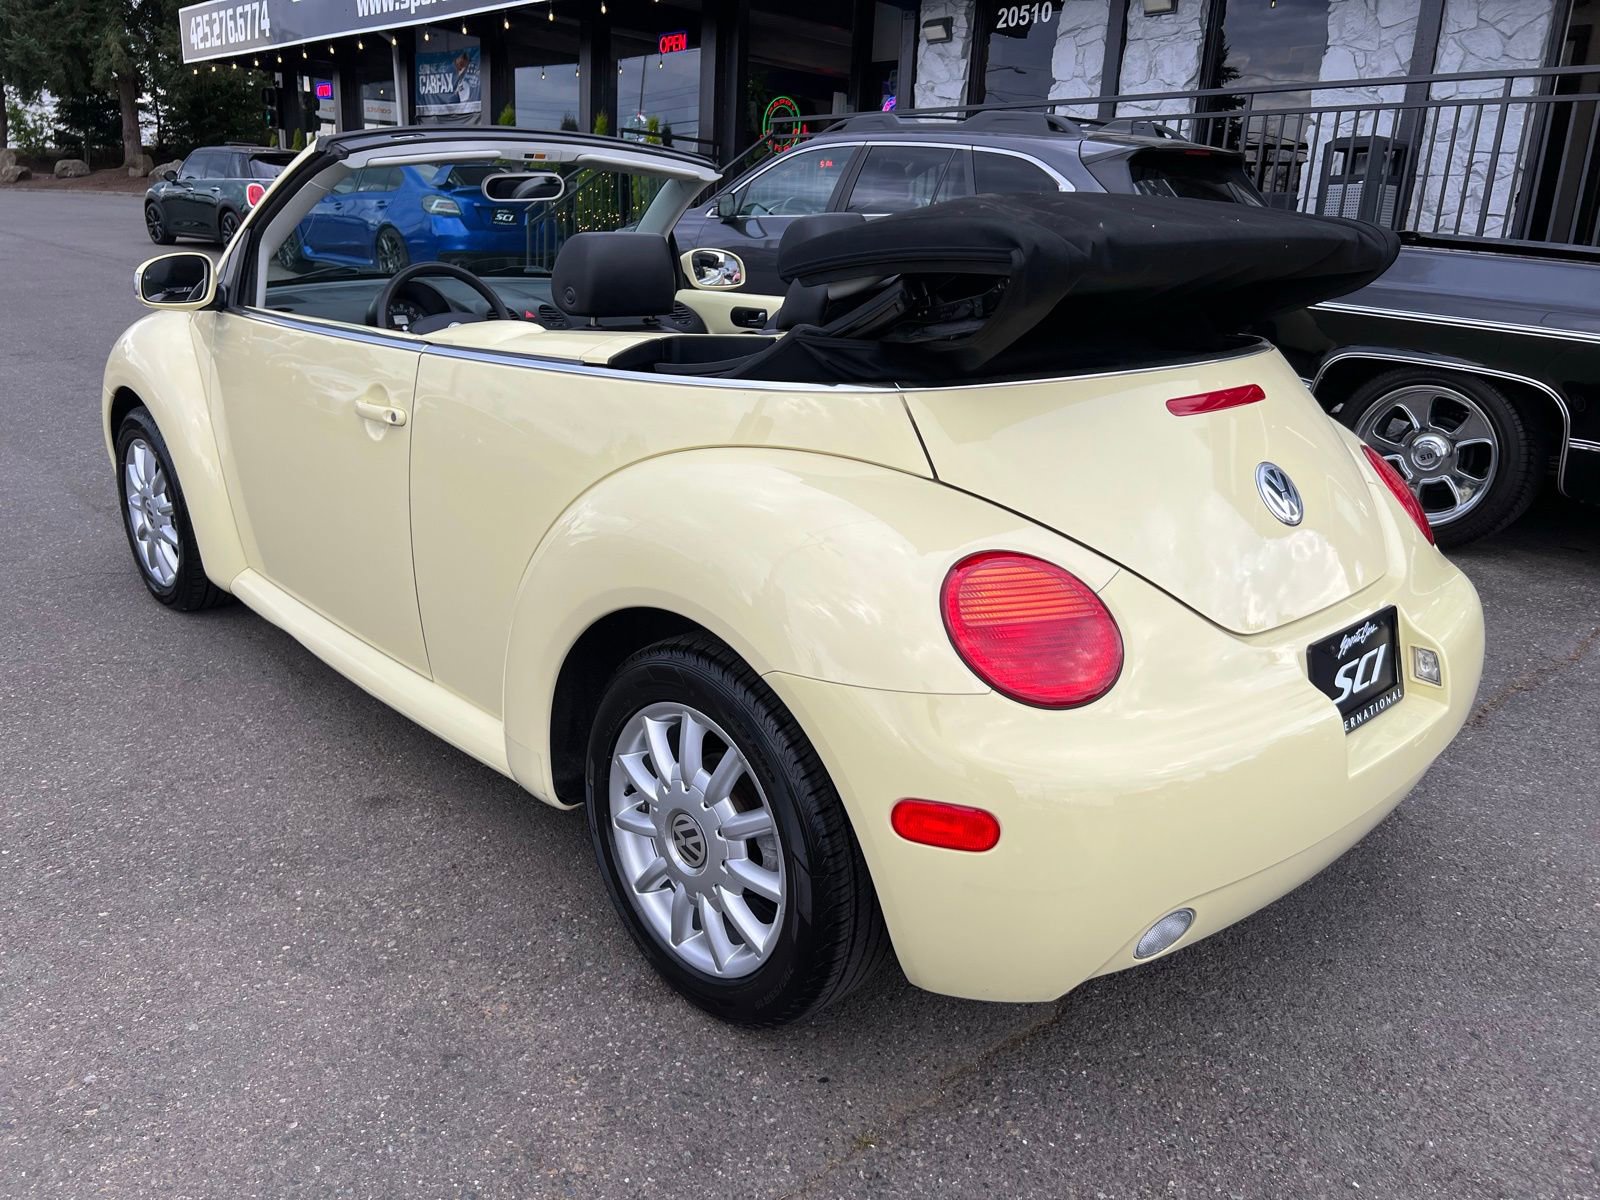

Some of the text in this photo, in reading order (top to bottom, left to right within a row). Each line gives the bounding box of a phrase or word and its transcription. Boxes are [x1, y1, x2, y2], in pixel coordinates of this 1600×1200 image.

[190, 0, 270, 50] 425.276.6774
[996, 1, 1053, 29] 20510
[660, 33, 687, 54] OPEN
[419, 73, 453, 95] CARFAX
[1332, 644, 1387, 705] SCI
[1343, 688, 1402, 731] ERNATIONAL
